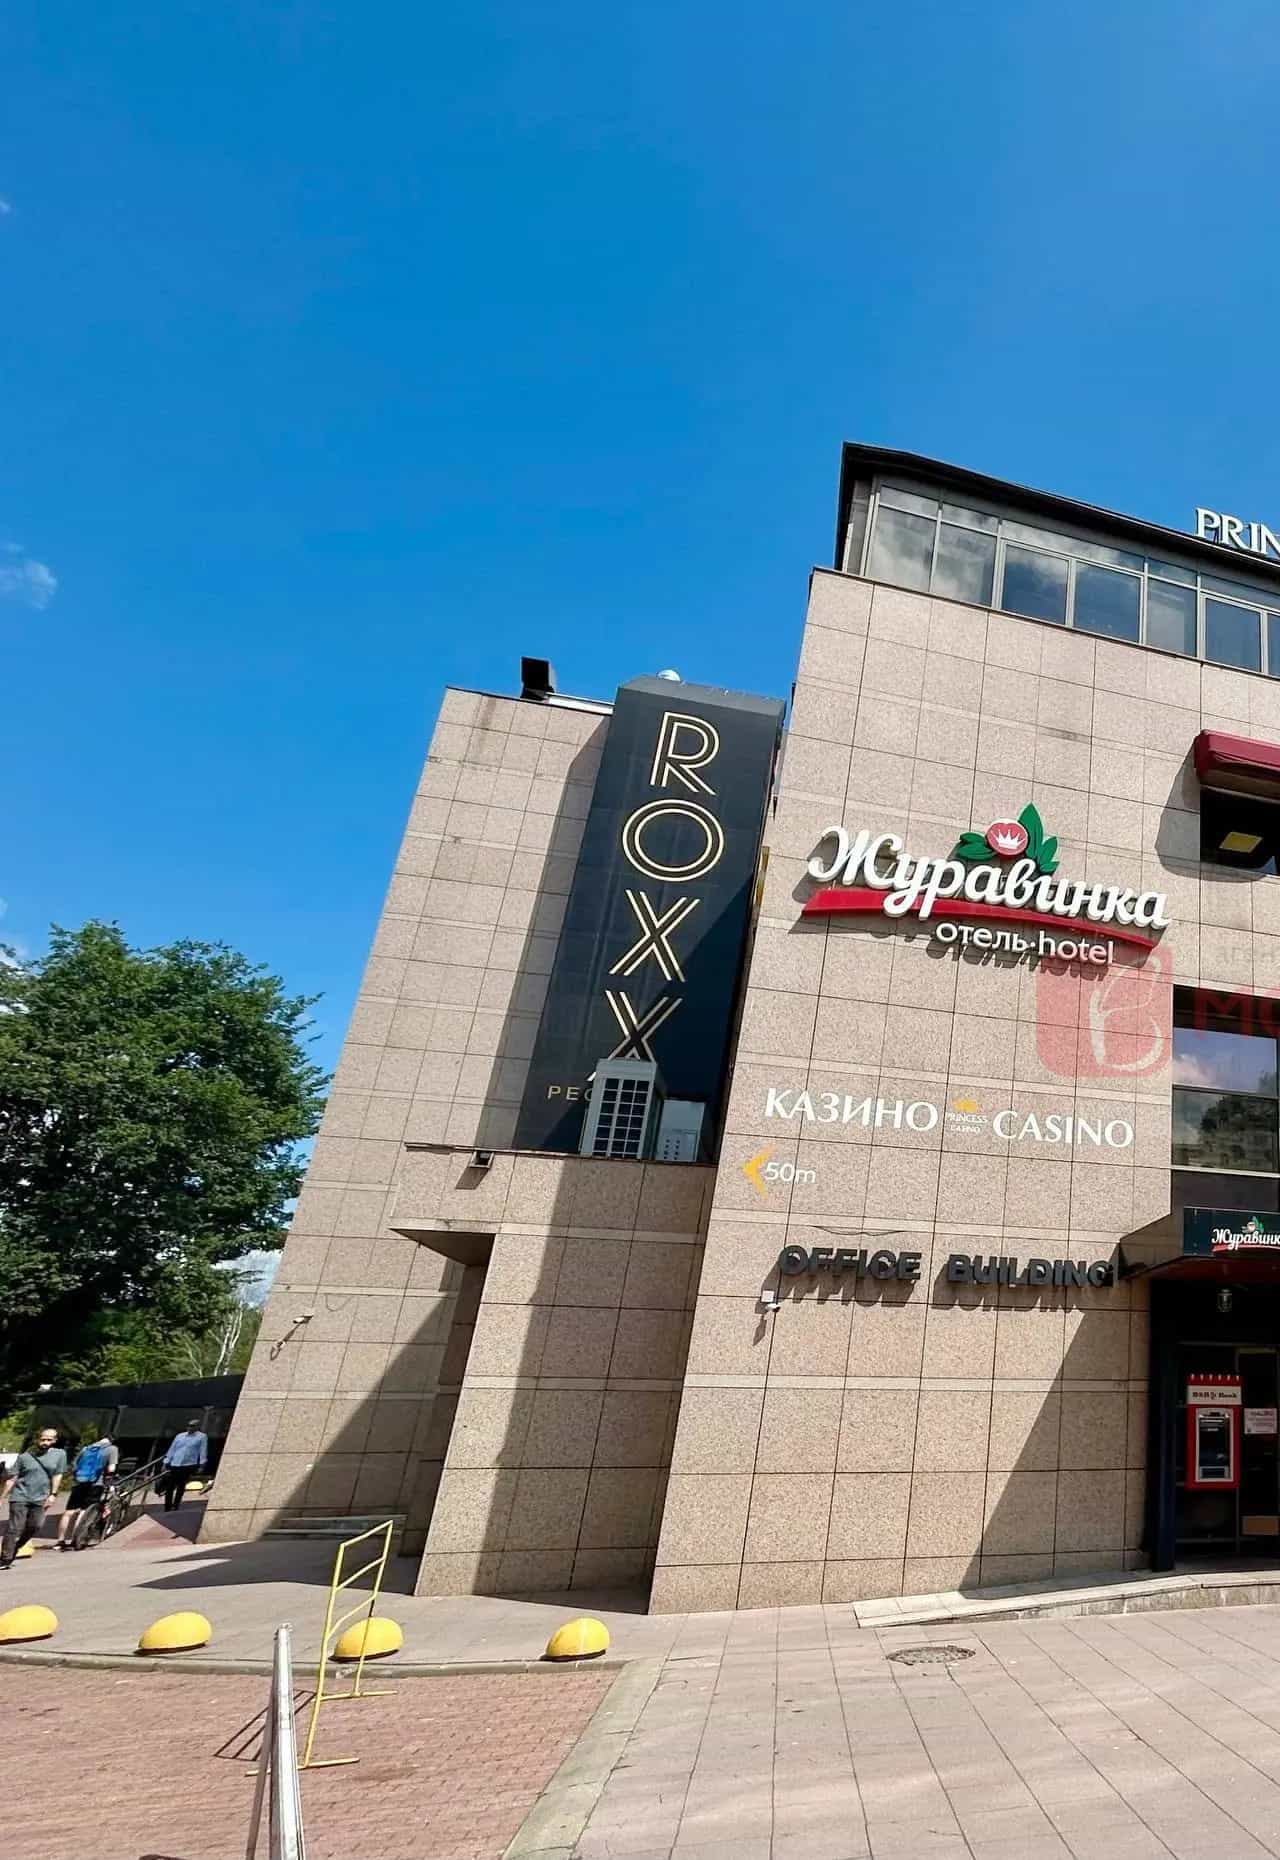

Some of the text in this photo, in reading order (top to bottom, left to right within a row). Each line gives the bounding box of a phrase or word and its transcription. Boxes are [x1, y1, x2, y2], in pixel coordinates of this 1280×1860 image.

[808, 825, 1172, 928] Журавинка
[764, 1088, 939, 1132] КАЗИНО
[993, 1110, 1134, 1148] CASINO
[764, 1161, 817, 1185] 50m
[778, 1245, 1116, 1288] OFFICE BUILDING
